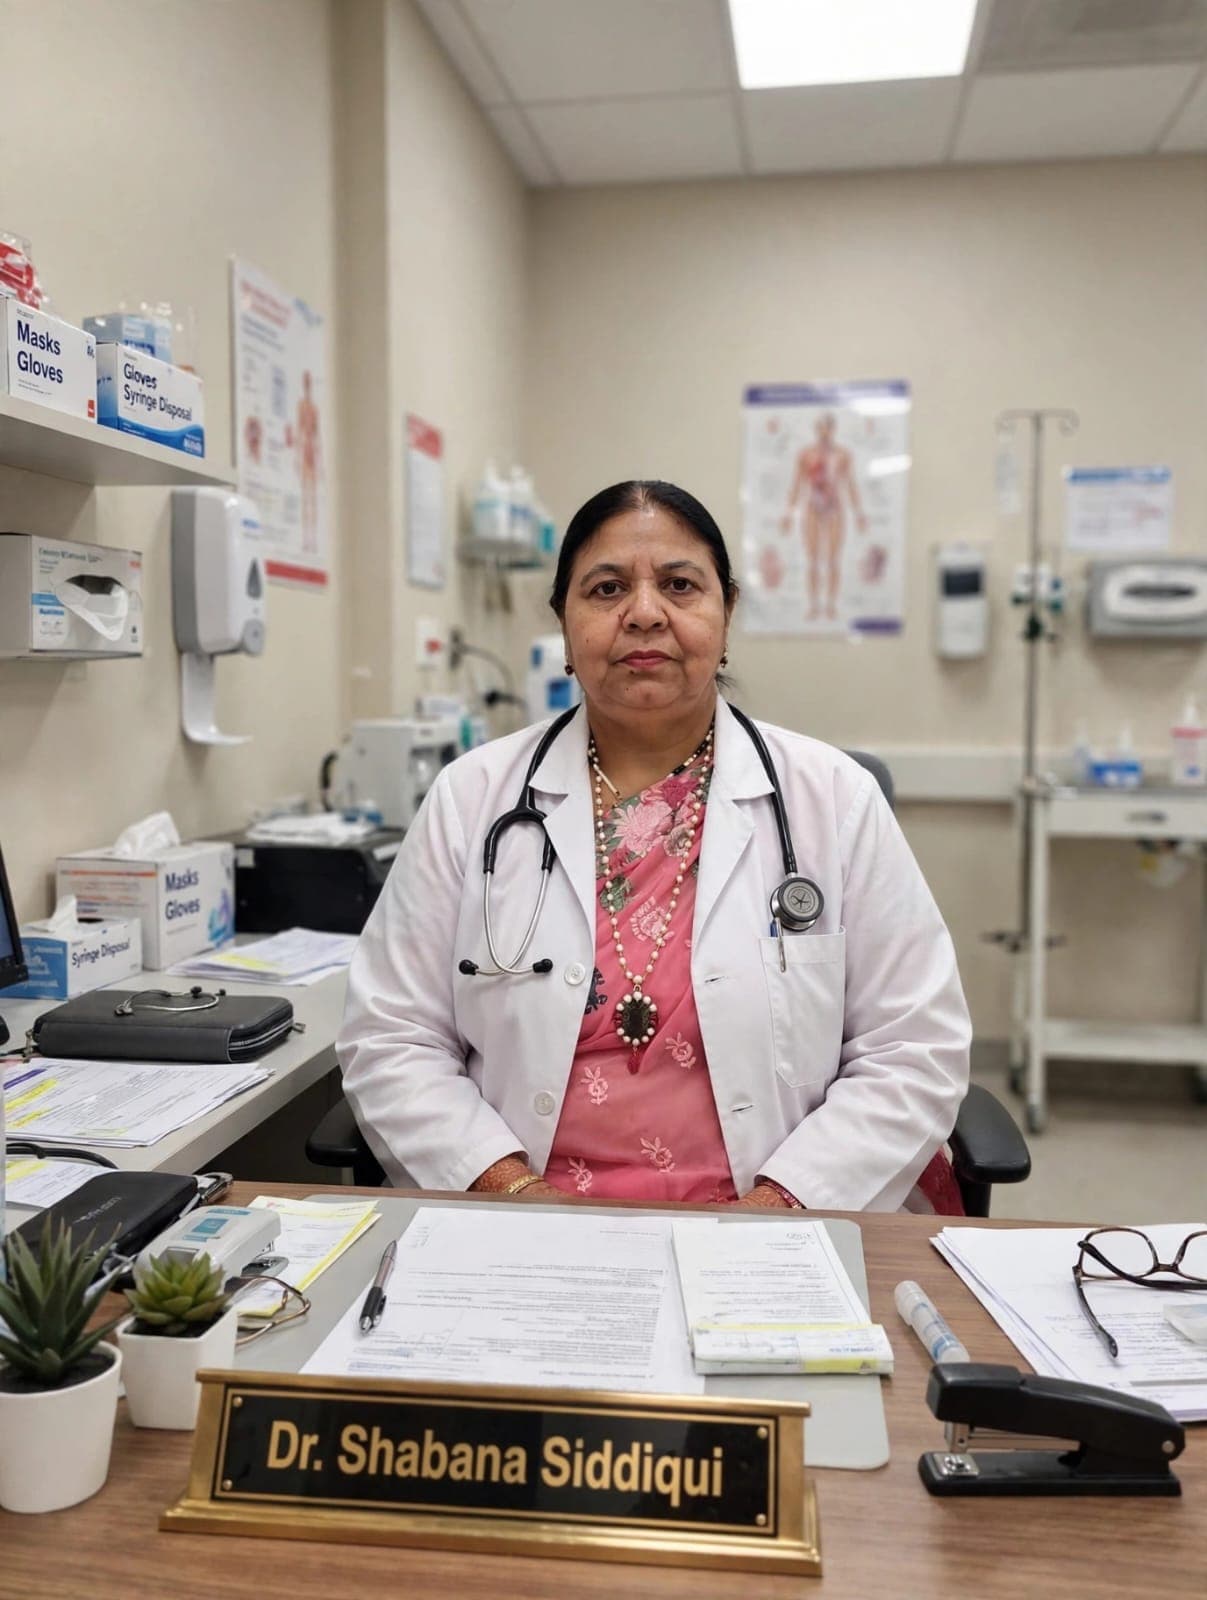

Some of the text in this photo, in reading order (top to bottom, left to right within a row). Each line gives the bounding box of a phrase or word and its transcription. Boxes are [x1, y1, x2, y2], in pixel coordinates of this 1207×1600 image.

[17, 319, 61, 356] Masks
[17, 350, 64, 384] Gloves
[123, 363, 158, 389] Gloves
[123, 384, 192, 421] Syringe Disposal
[165, 870, 199, 892] Masks
[165, 898, 200, 921] Gloves
[72, 947, 100, 969] Syringe
[101, 937, 130, 958] Disposal
[266, 1419, 724, 1507] Dr. Shabana Siddiqui
